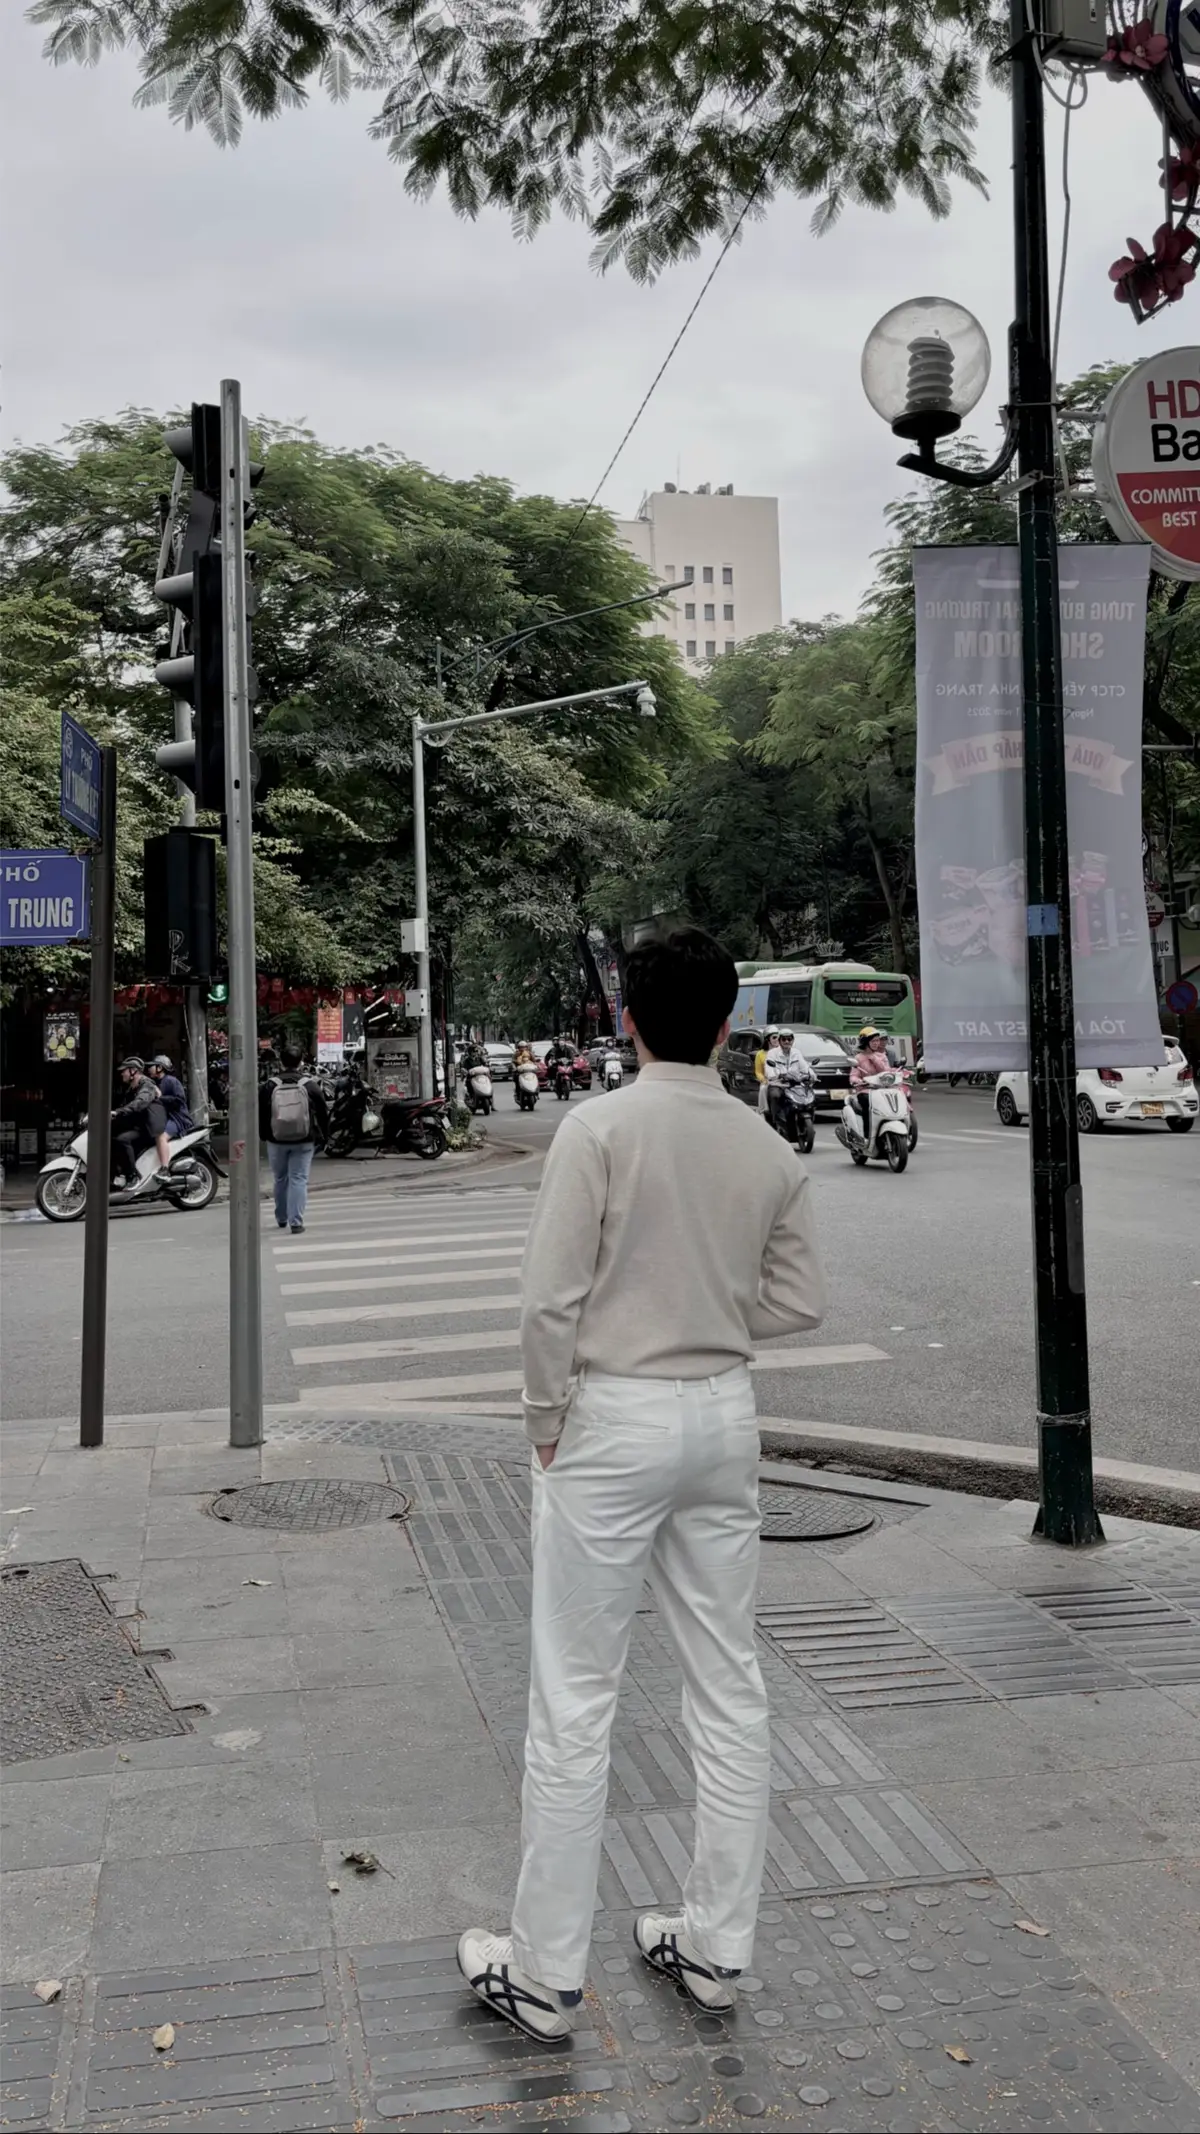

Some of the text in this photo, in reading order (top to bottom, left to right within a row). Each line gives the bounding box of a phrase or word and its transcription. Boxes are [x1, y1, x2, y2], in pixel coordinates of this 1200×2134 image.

[1147, 380, 1200, 420] HD
[1151, 423, 1200, 463] Ba
[1162, 511, 1197, 528] BEST
[0, 860, 42, 882] HỐ
[8, 896, 74, 928] TRUNG
